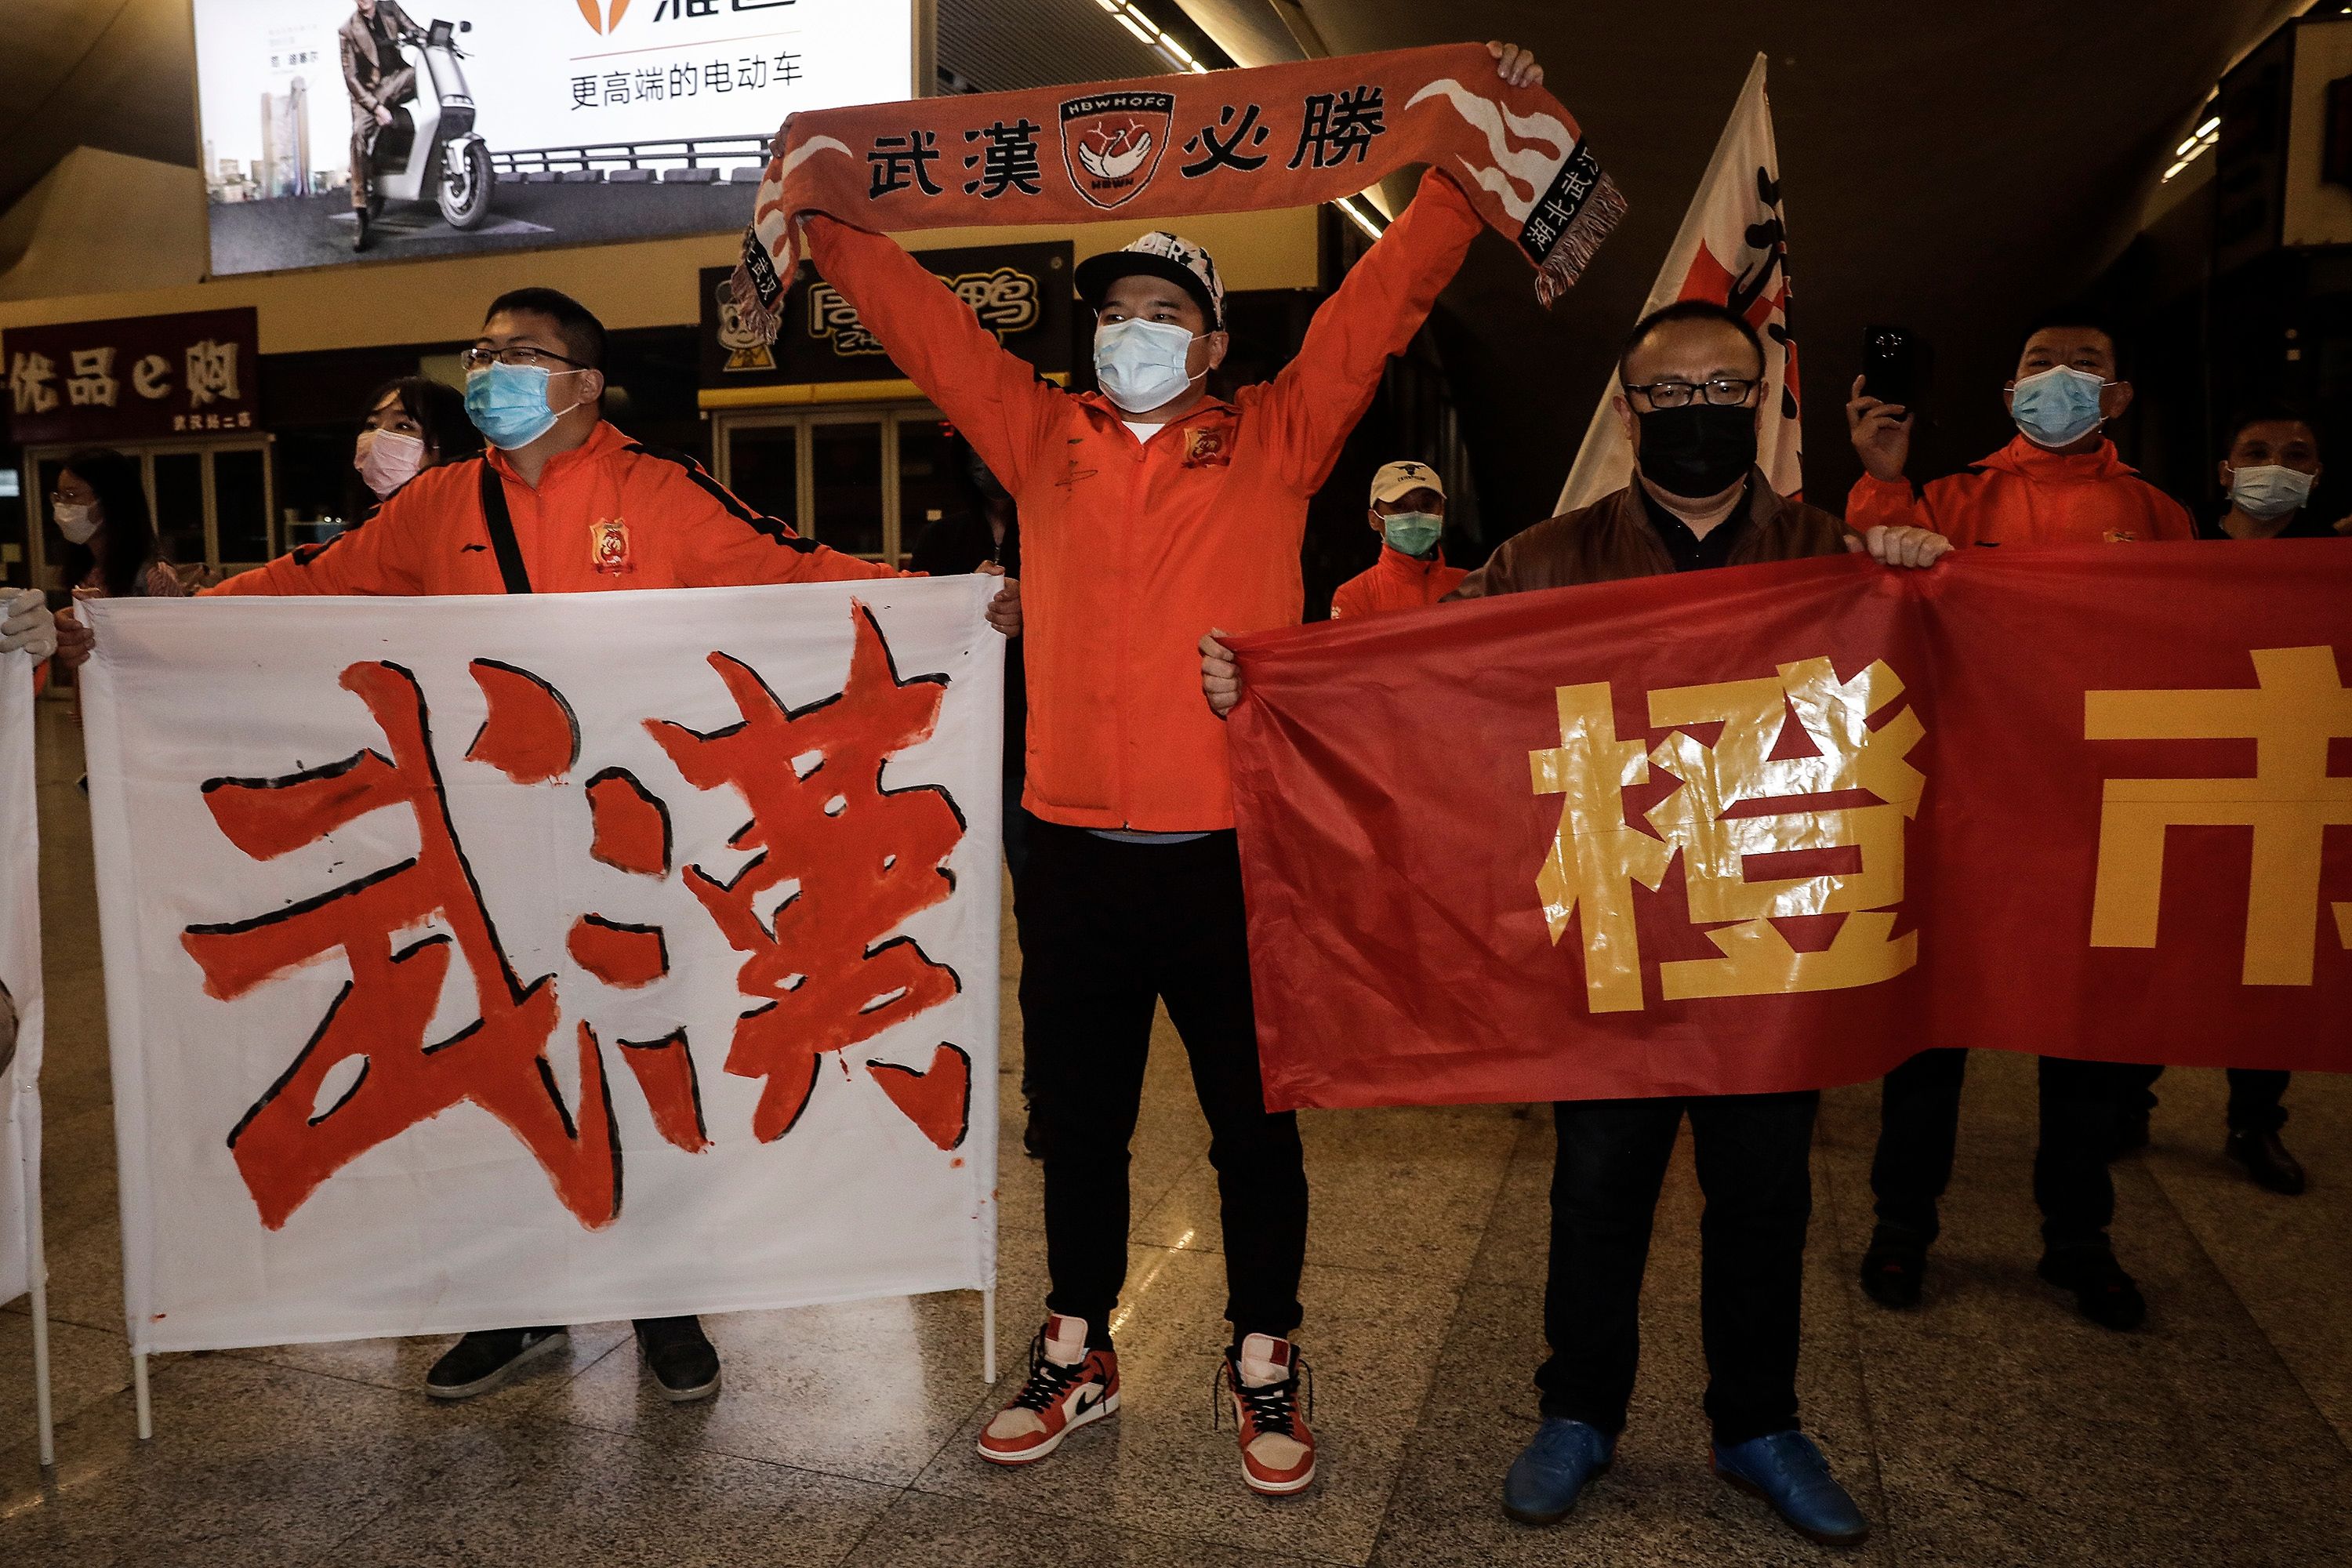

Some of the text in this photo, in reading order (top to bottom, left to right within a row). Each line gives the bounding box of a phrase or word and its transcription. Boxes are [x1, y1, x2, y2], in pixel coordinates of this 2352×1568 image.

[571, 51, 803, 111] 更高端的电动车
[866, 85, 1387, 200] 武漢 必勝
[180, 597, 973, 1231] 武漢
